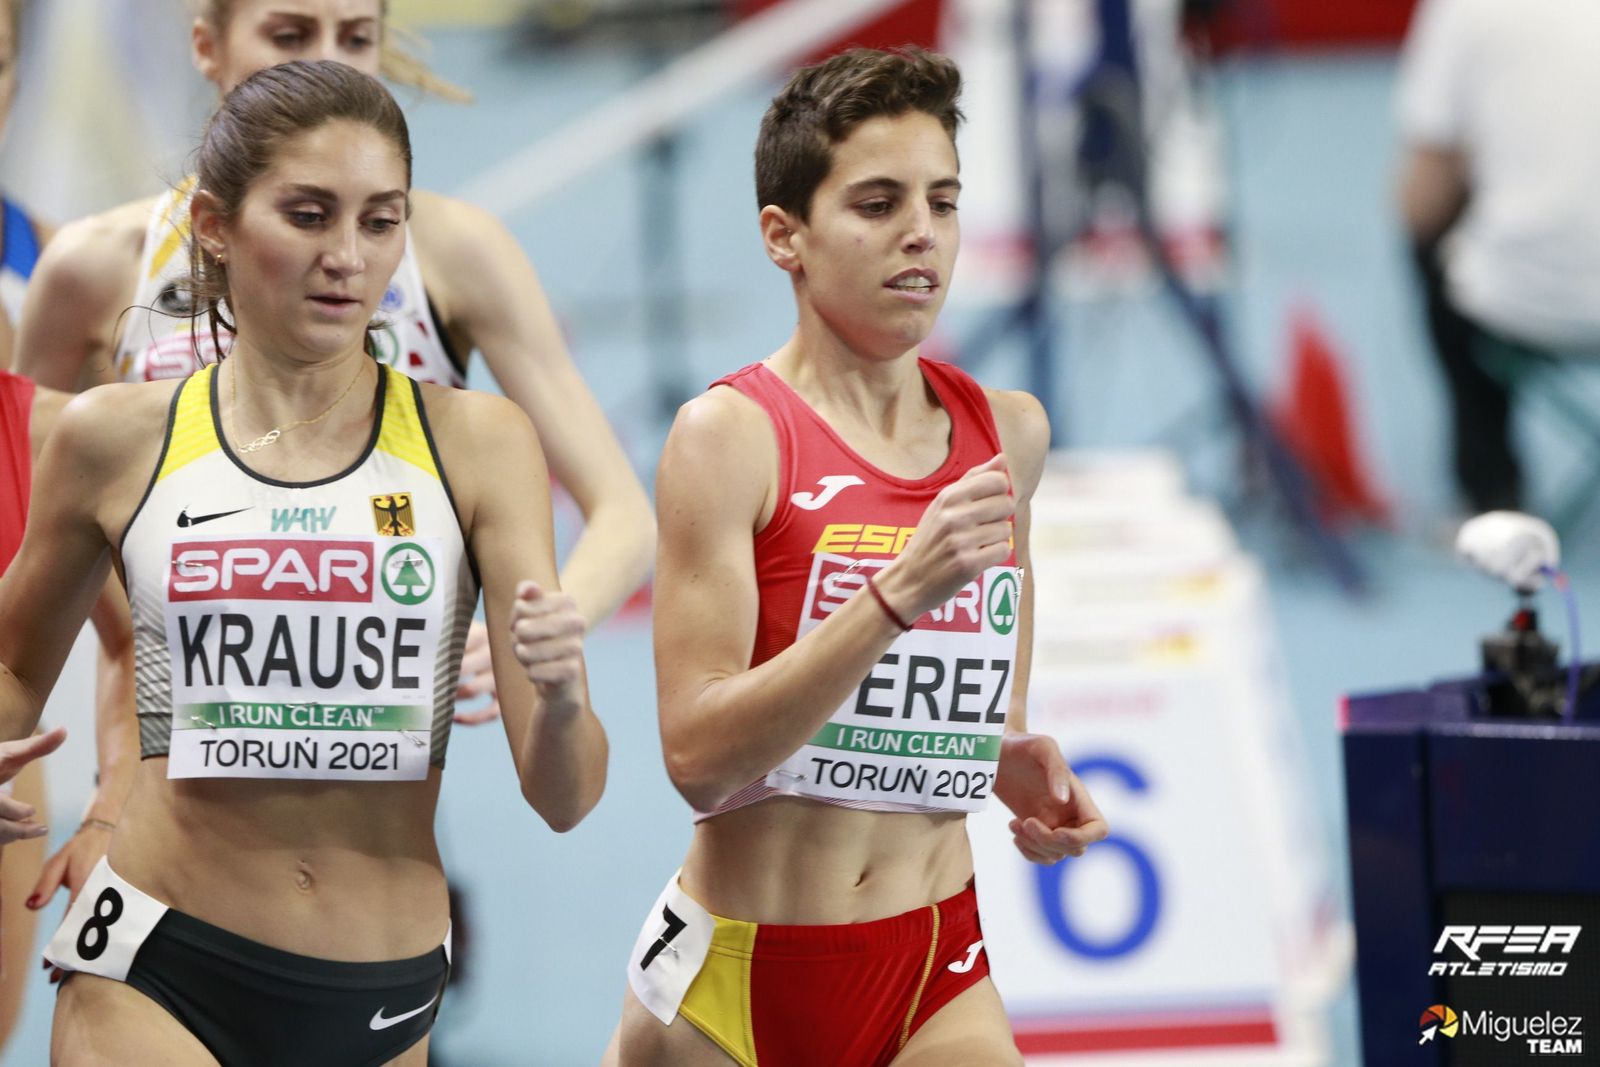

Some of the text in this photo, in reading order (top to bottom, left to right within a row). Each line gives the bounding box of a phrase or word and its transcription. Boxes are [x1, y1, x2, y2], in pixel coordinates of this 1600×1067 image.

[173, 547, 369, 594] SPAR
[177, 613, 427, 691] KRAUSE
[219, 706, 224, 725] I
[230, 704, 282, 725] RUN
[854, 652, 1011, 724] EREZ
[200, 737, 399, 771] TORUŃ 2021
[836, 727, 846, 746] I
[850, 729, 903, 752] RUN
[811, 757, 928, 794] TORUŃ
[1034, 753, 1163, 963] 6
[76, 886, 124, 961] 8
[640, 902, 688, 972] 7
